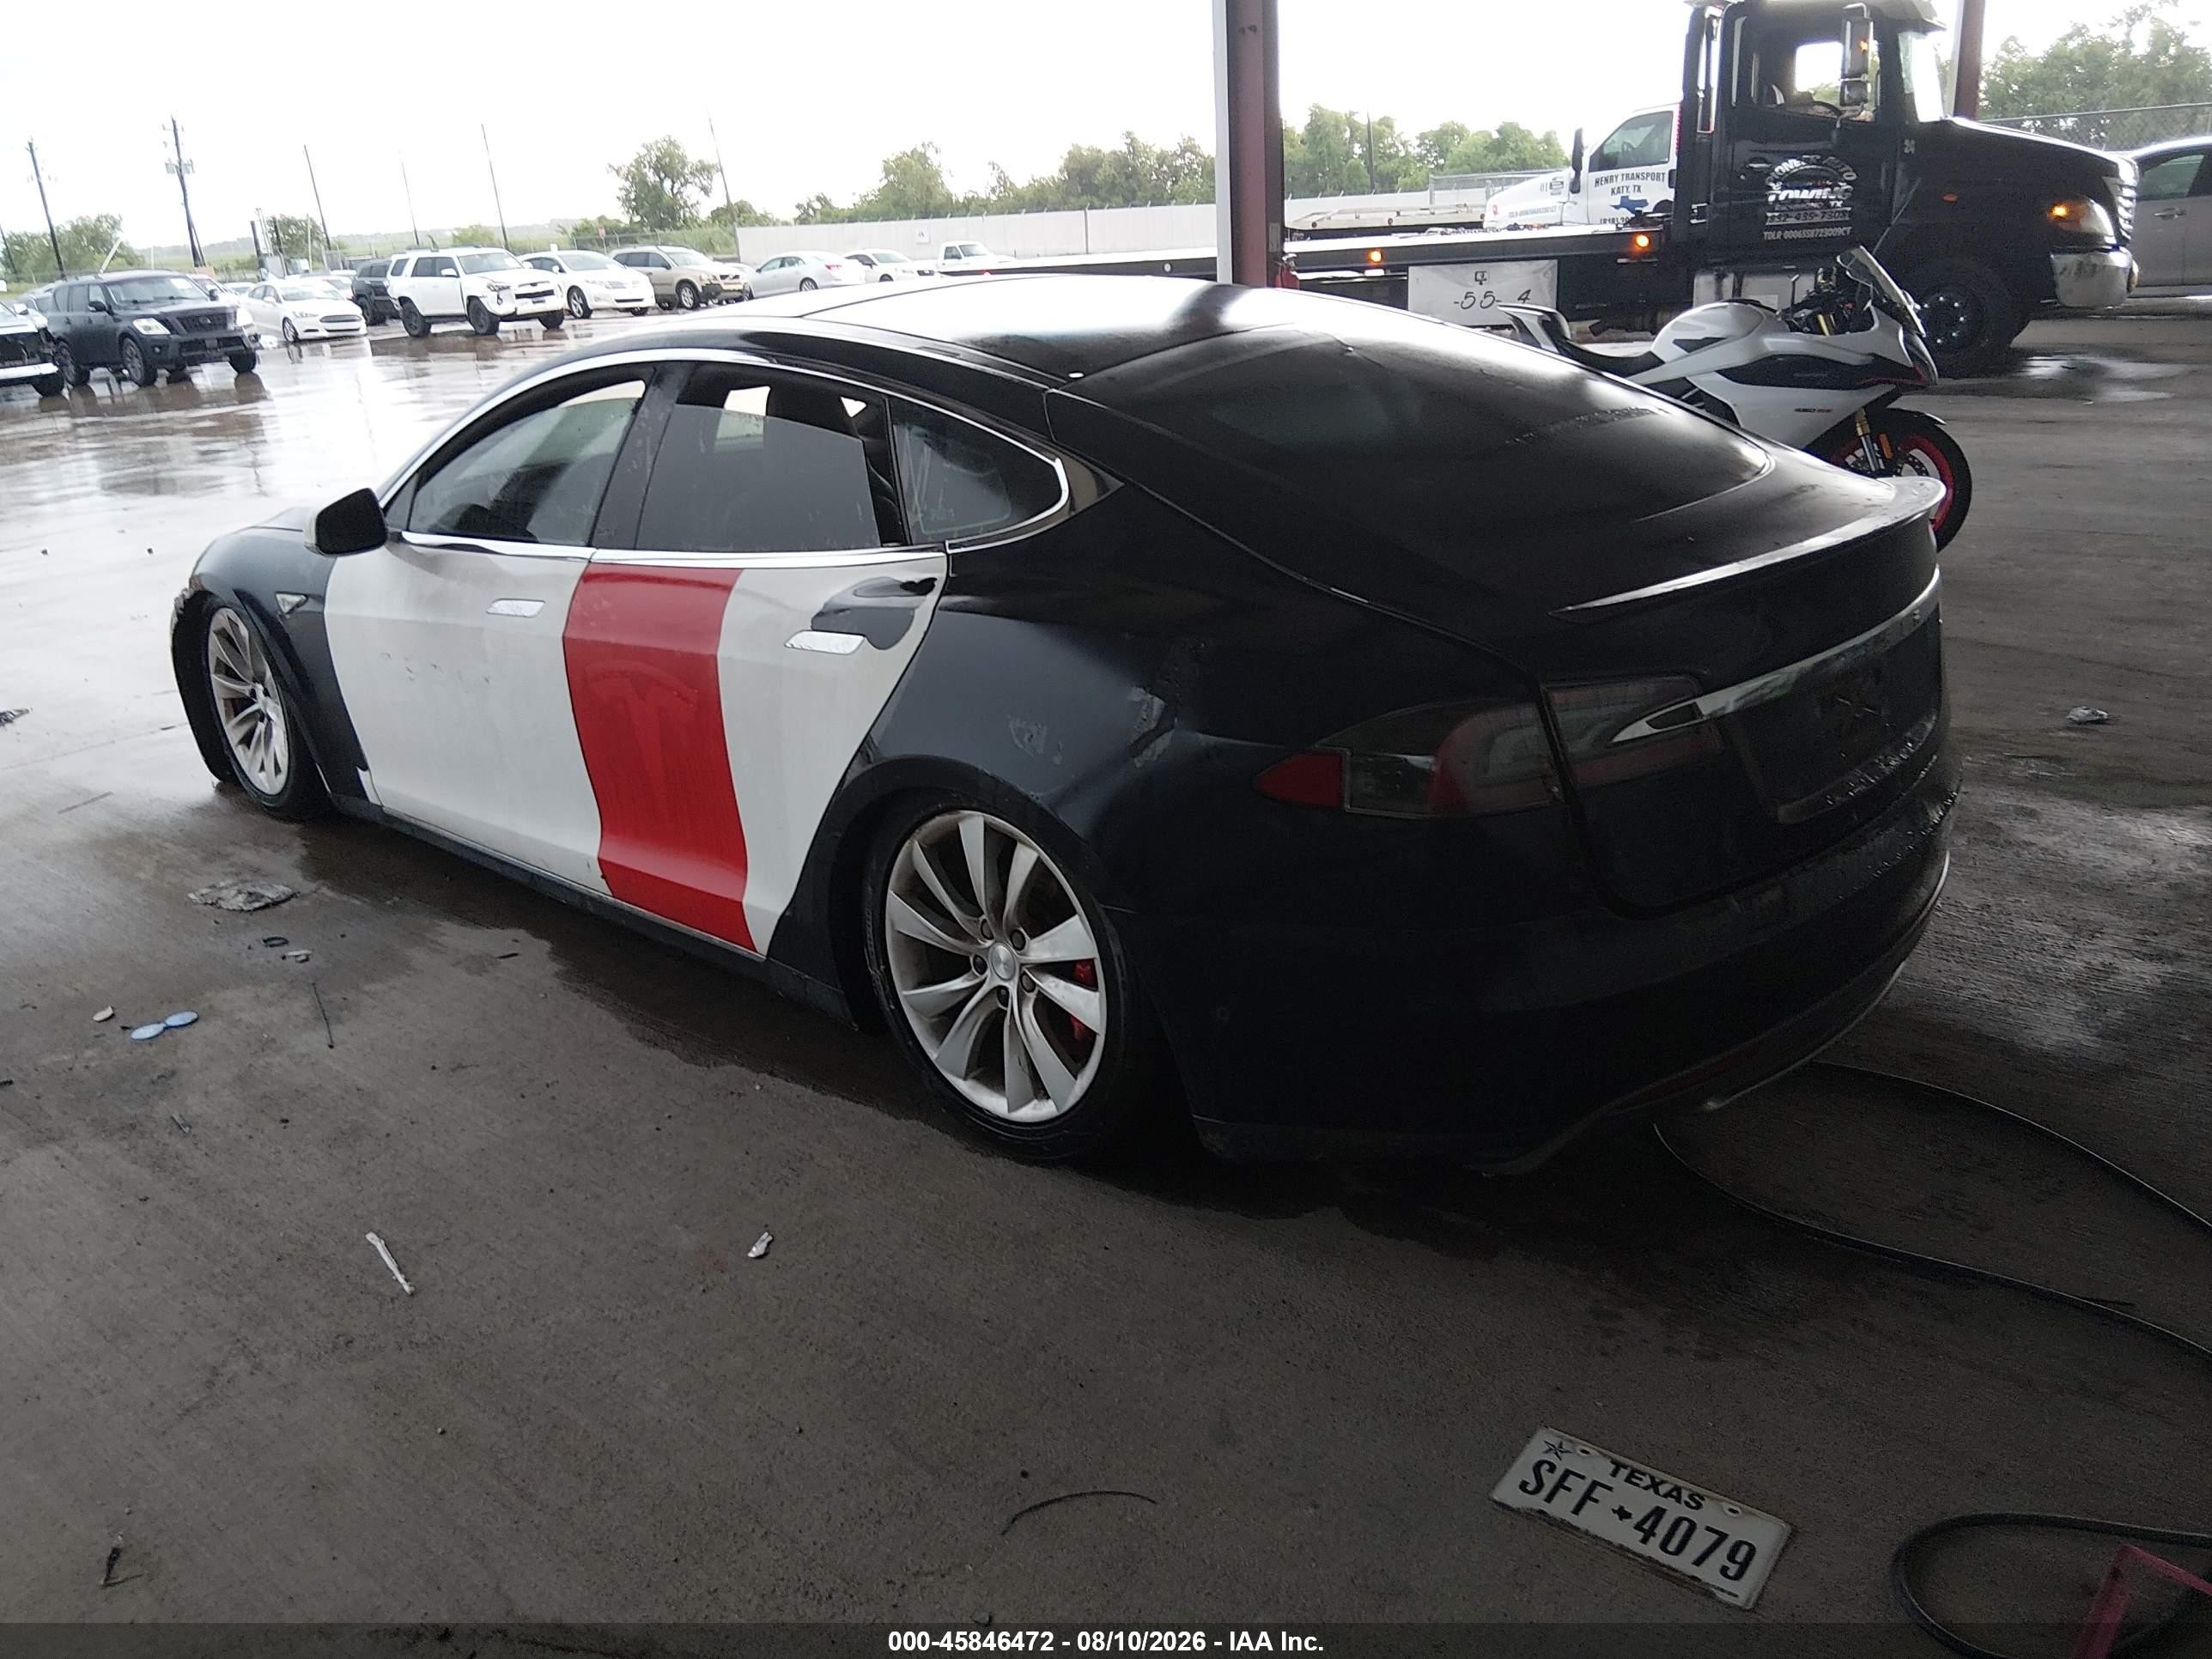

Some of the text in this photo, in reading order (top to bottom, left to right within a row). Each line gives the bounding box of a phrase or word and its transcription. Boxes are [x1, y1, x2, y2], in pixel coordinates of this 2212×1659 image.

[1595, 173, 1666, 187] HENRY TRANSPORT
[1633, 185, 1642, 193] TX
[1766, 185, 1854, 204] TOWING
[1608, 1460, 1706, 1511] TEXAS
[1518, 1459, 1757, 1582] SFF 4079
